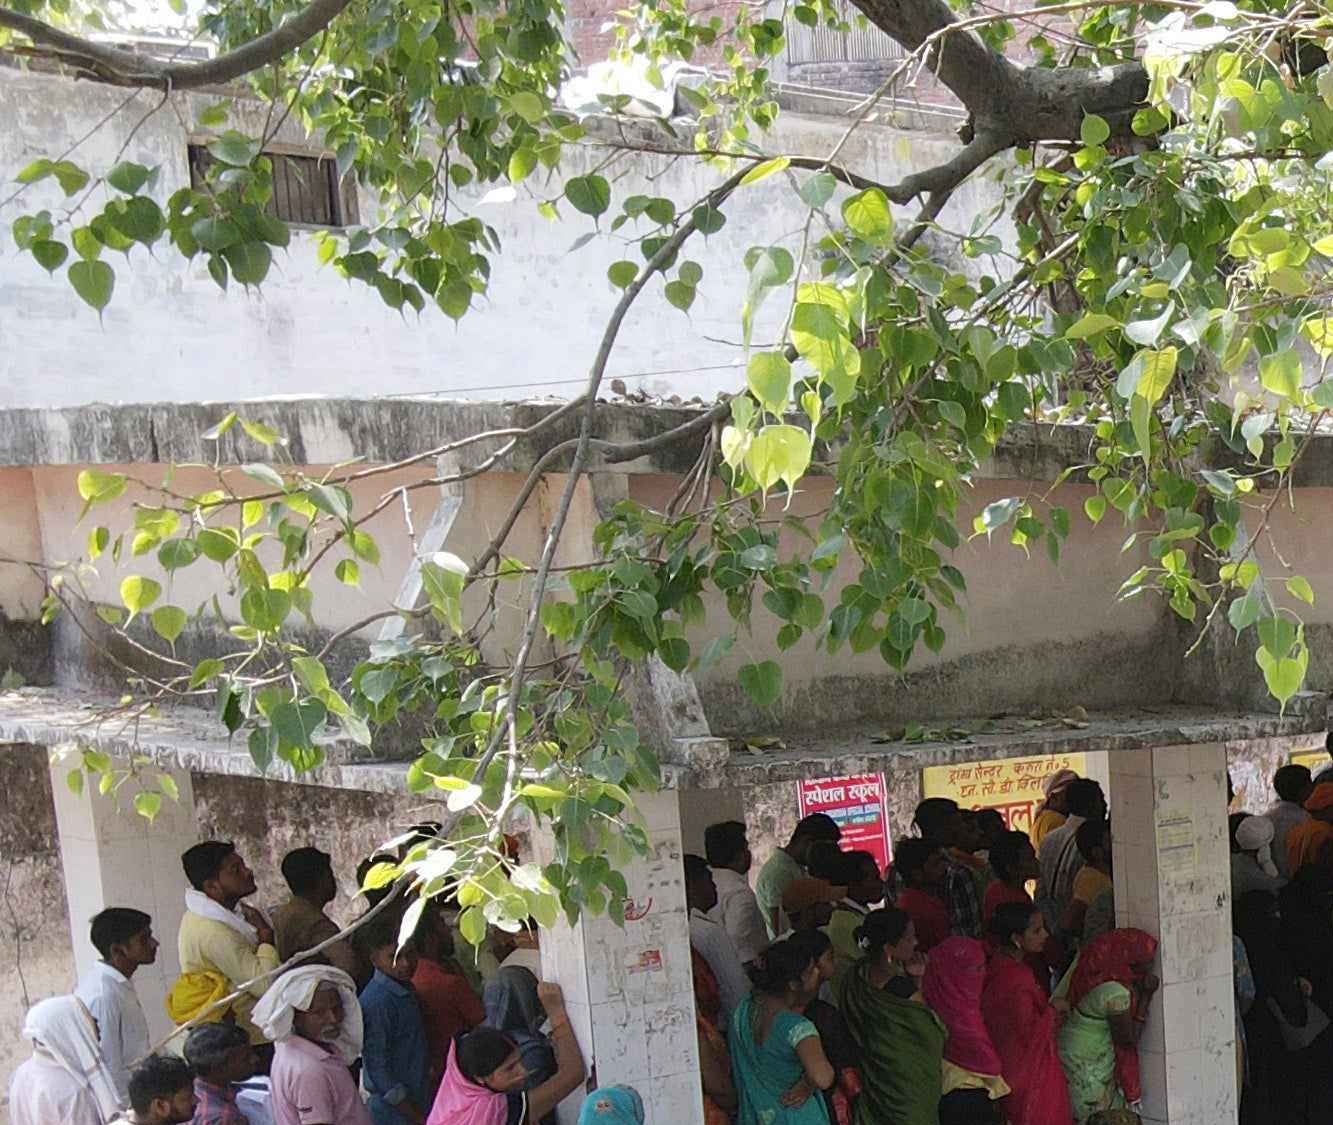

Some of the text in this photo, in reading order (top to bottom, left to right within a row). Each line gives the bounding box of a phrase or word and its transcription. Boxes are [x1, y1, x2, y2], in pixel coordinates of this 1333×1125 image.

[1062, 757, 1070, 769] 5
[804, 783, 880, 806] स्पेशल स्कूल
